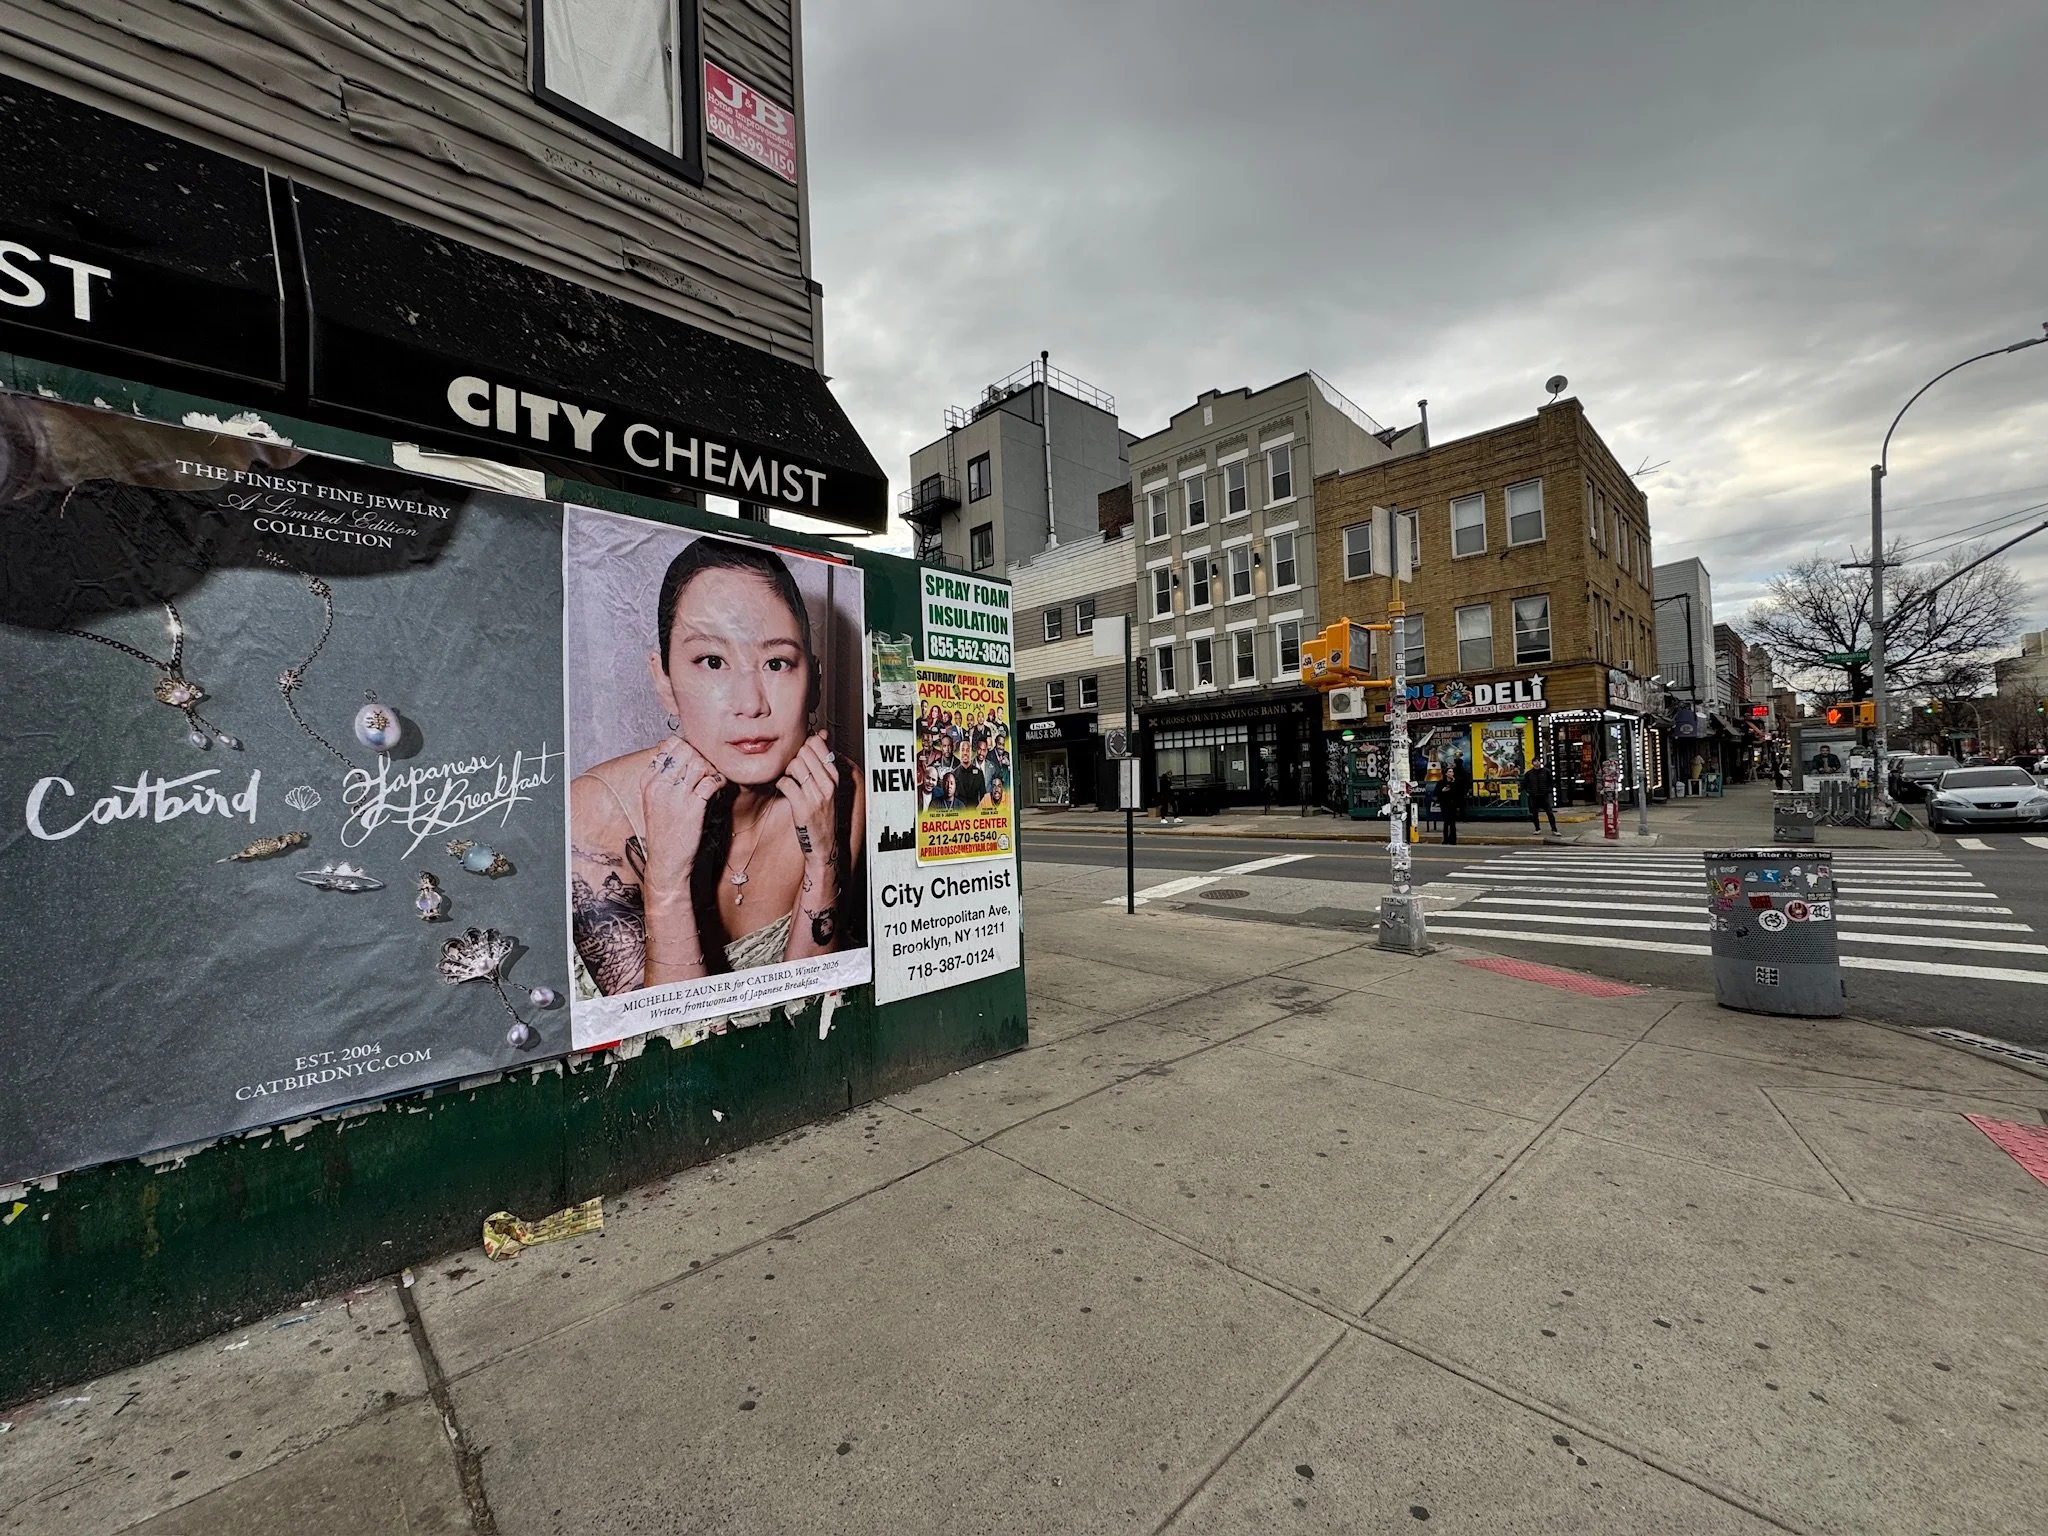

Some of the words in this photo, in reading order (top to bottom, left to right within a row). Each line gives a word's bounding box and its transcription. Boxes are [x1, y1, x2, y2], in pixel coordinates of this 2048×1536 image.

[708, 92, 733, 115] Home
[735, 110, 794, 149] Improvements
[709, 113, 795, 175] 800-599-1150
[447, 375, 606, 453] CITY
[623, 423, 827, 506] CHEMIST
[175, 459, 229, 481] THE
[233, 470, 313, 496] FINEST
[317, 486, 365, 505] FINE
[366, 494, 451, 520] JEWELRY
[218, 492, 263, 511] A
[257, 494, 346, 526] Limited
[346, 509, 420, 537] Edition
[253, 518, 393, 549] COLLECTION
[925, 574, 970, 602] SPRAY
[974, 584, 1009, 609] FOAM
[928, 603, 1009, 635] INSULATION
[930, 634, 1009, 664] 855-552-3626
[916, 670, 957, 684] SATURDAY
[957, 675, 978, 686] APRIL
[987, 678, 1004, 689] 2026
[919, 683, 955, 700] APRIL
[962, 687, 1005, 704] FOOLS
[1406, 684, 1435, 699] NE
[941, 700, 972, 710] COMEDY
[972, 703, 985, 712] JAM
[1161, 715, 1185, 726] CROSS
[1187, 711, 1220, 724] COUNTY
[1221, 707, 1260, 720] SAVINGS
[1261, 704, 1288, 716] BANK
[1025, 730, 1043, 741] NAILS
[1043, 729, 1049, 739] &
[1049, 727, 1062, 739] SPA
[879, 745, 906, 763] WE
[872, 768, 915, 792] NEW
[26, 769, 262, 841] Catbird
[341, 751, 500, 848] Japanese
[400, 741, 565, 860] Breakfast
[921, 819, 970, 833] BARCLAYS
[973, 817, 1008, 830] CENTER
[928, 831, 997, 846] 212-470-6540
[920, 842, 998, 857] APRILFOOLSCOMEDYJAM.COM
[881, 883, 924, 908] City
[931, 869, 1011, 899] Chemist
[884, 921, 907, 938] 710
[911, 909, 985, 932] Metropolitan
[988, 904, 1011, 918] Ave,
[892, 935, 951, 957] Brooklyn,
[955, 928, 971, 944] NY
[974, 921, 1005, 938] 11211
[907, 947, 995, 981] 718-387-0124
[622, 991, 683, 1013] MICHELLE
[685, 983, 730, 998] ZAUNER
[732, 979, 745, 993] for
[746, 970, 793, 986] CATBIRD,
[794, 964, 820, 977] Winter
[822, 959, 840, 971] 2026
[650, 1005, 682, 1020] Writer,
[682, 994, 738, 1015] frontwoman
[739, 989, 749, 1002] of
[749, 984, 783, 1002] Japanese
[784, 976, 819, 991] Breakfast
[295, 1051, 337, 1071] EST.
[342, 1041, 382, 1060] 2004
[235, 1048, 432, 1101] CATBIRDNYC.COM
